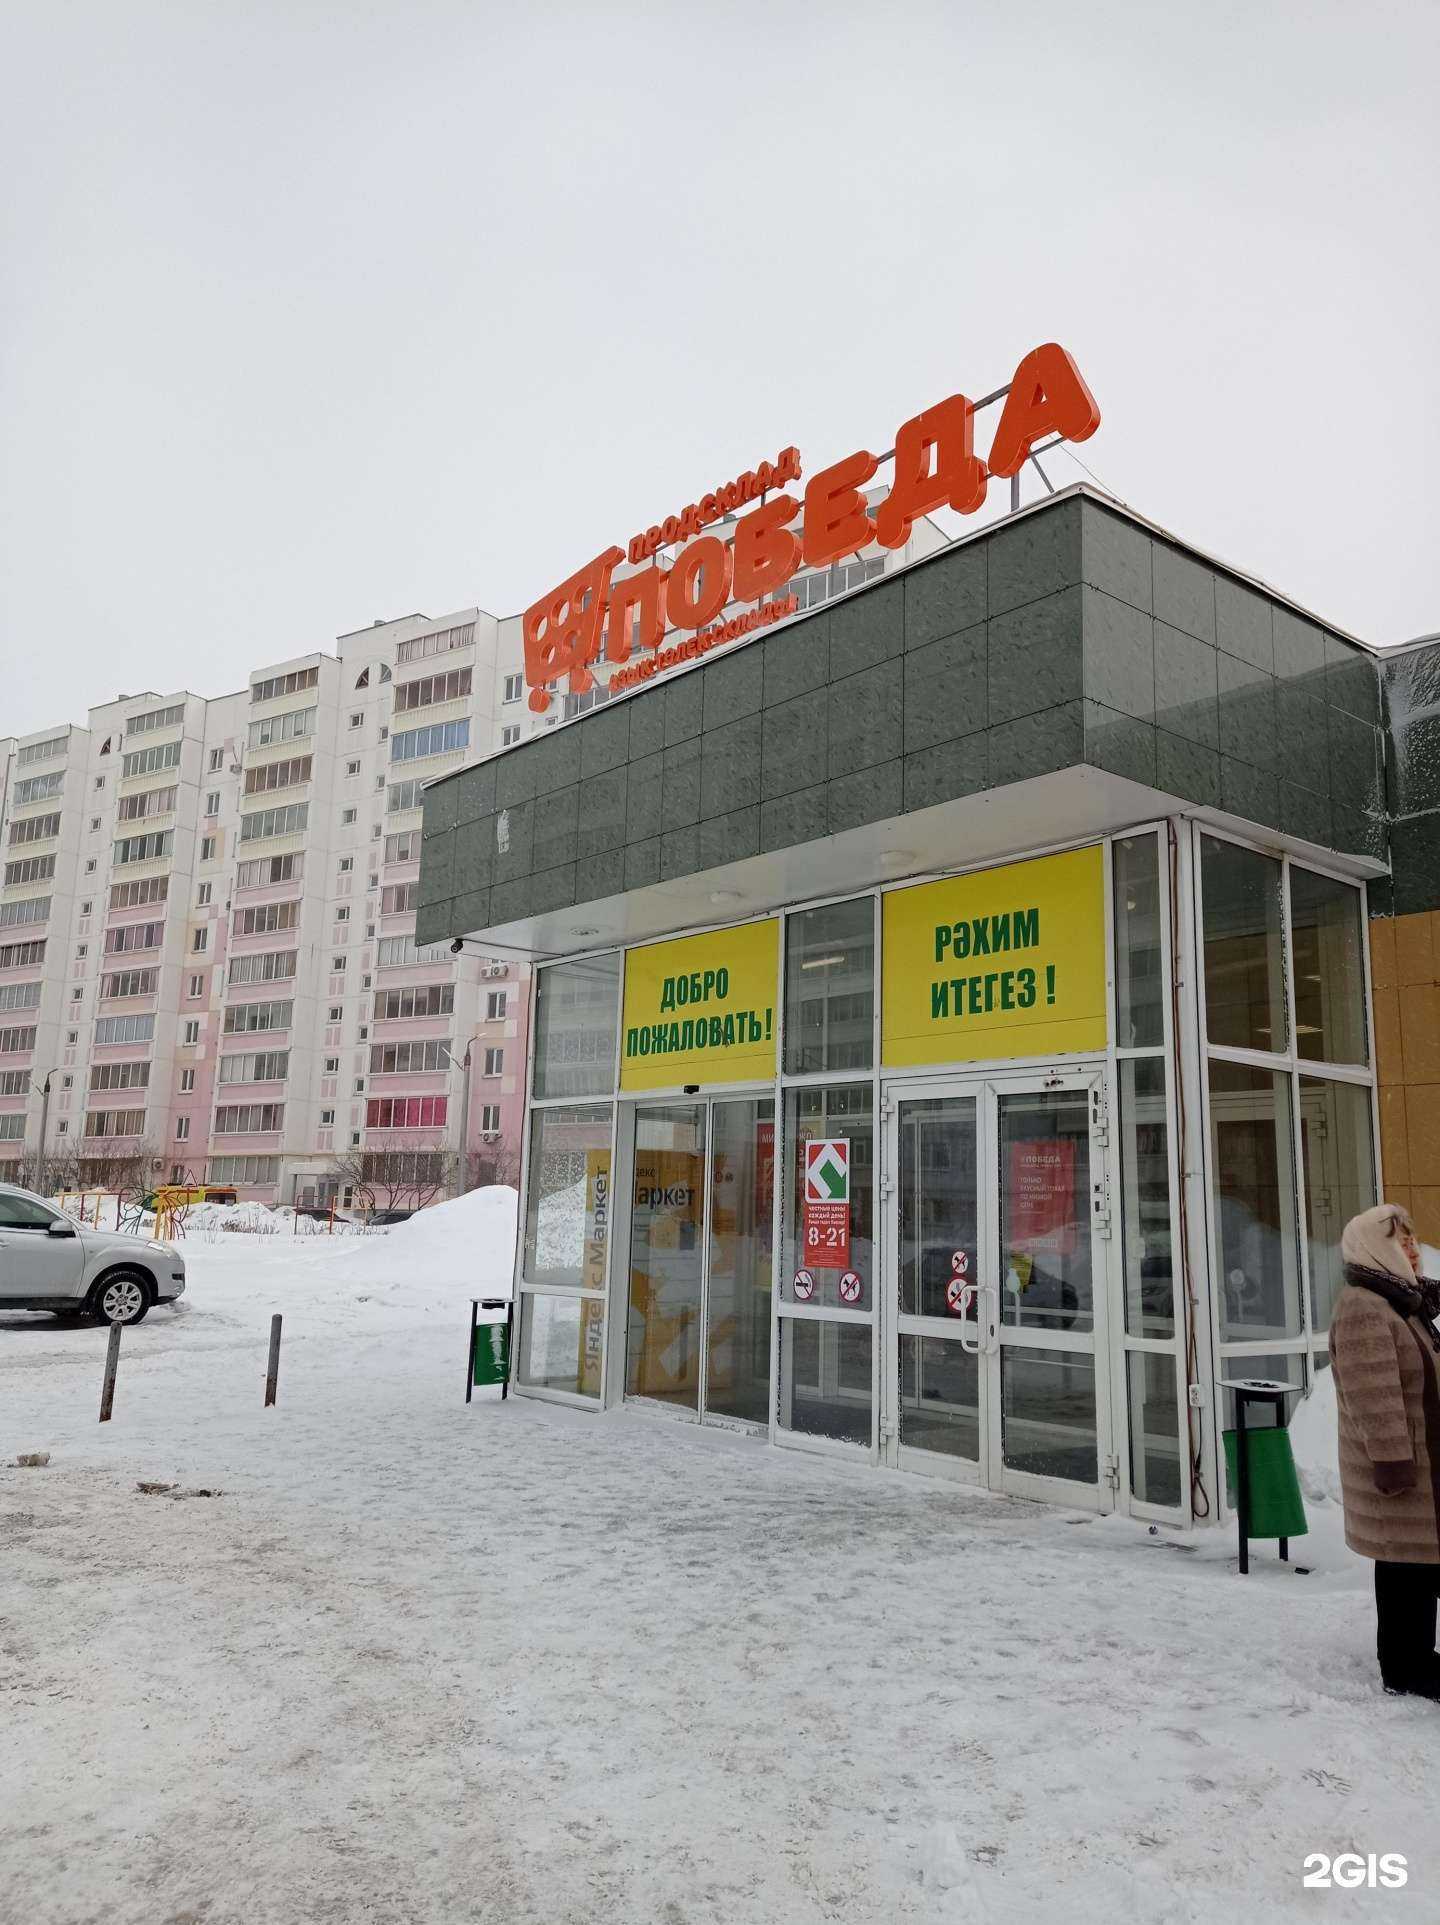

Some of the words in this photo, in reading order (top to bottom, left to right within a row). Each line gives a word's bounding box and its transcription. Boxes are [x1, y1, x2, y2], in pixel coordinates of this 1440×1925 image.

[606, 342, 1101, 664] ПОБЕДА
[628, 446, 802, 565] ПРОДСКЛАД
[935, 908, 1040, 963] РӘХИМ
[660, 967, 729, 1013] ДОБРО
[626, 1008, 773, 1058] ПОЖАЛОВАТЬ!
[589, 1165, 608, 1265] Маркет
[808, 1226, 846, 1247] 8-21
[584, 1272, 604, 1371] Яндес
